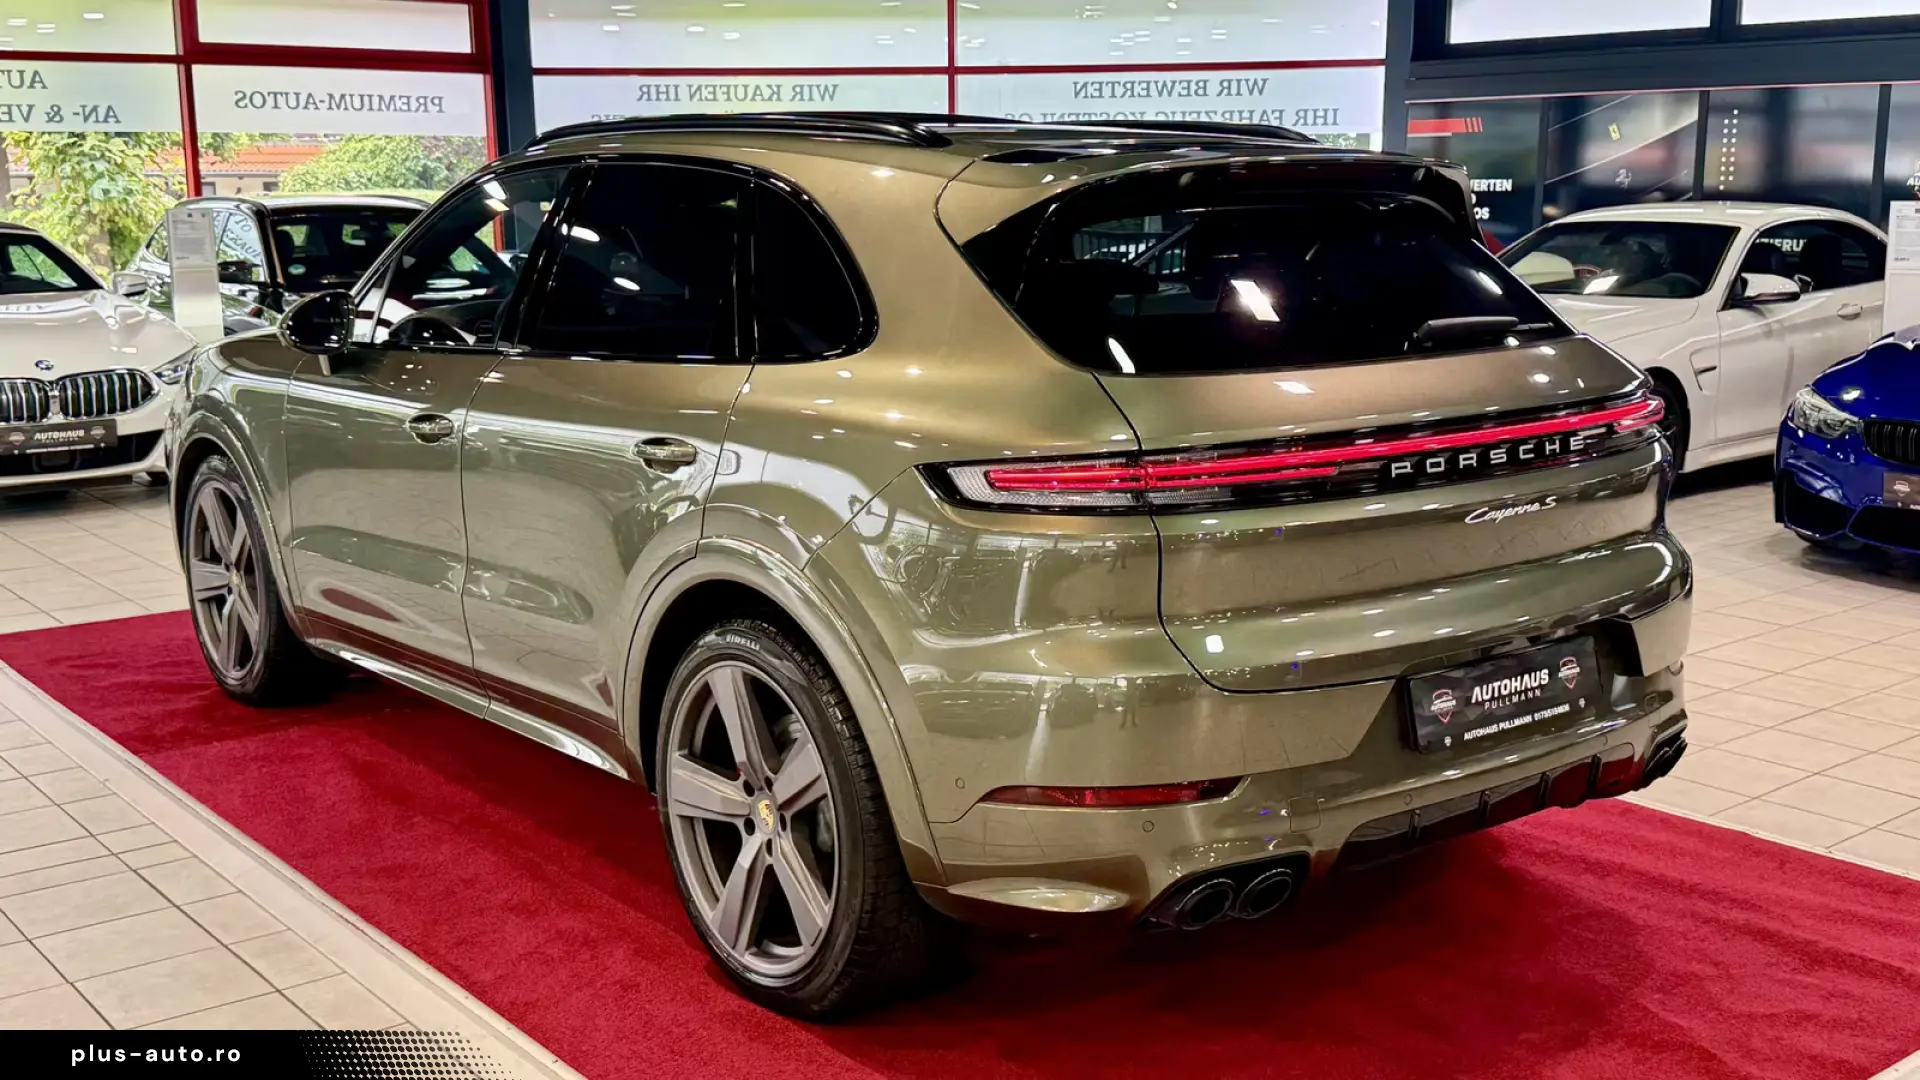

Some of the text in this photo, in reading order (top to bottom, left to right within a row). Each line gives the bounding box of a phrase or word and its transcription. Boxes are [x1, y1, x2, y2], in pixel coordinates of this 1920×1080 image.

[34, 429, 85, 440] AUTOHAUS
[1391, 436, 1586, 478] PORSCHE
[1464, 495, 1558, 524] Cayenne S
[1471, 668, 1549, 704] AUTOHAUS
[1484, 688, 1541, 711] PULLMANN
[1463, 724, 1499, 741] AUTOHAUS
[1498, 714, 1533, 732] PULLMANN
